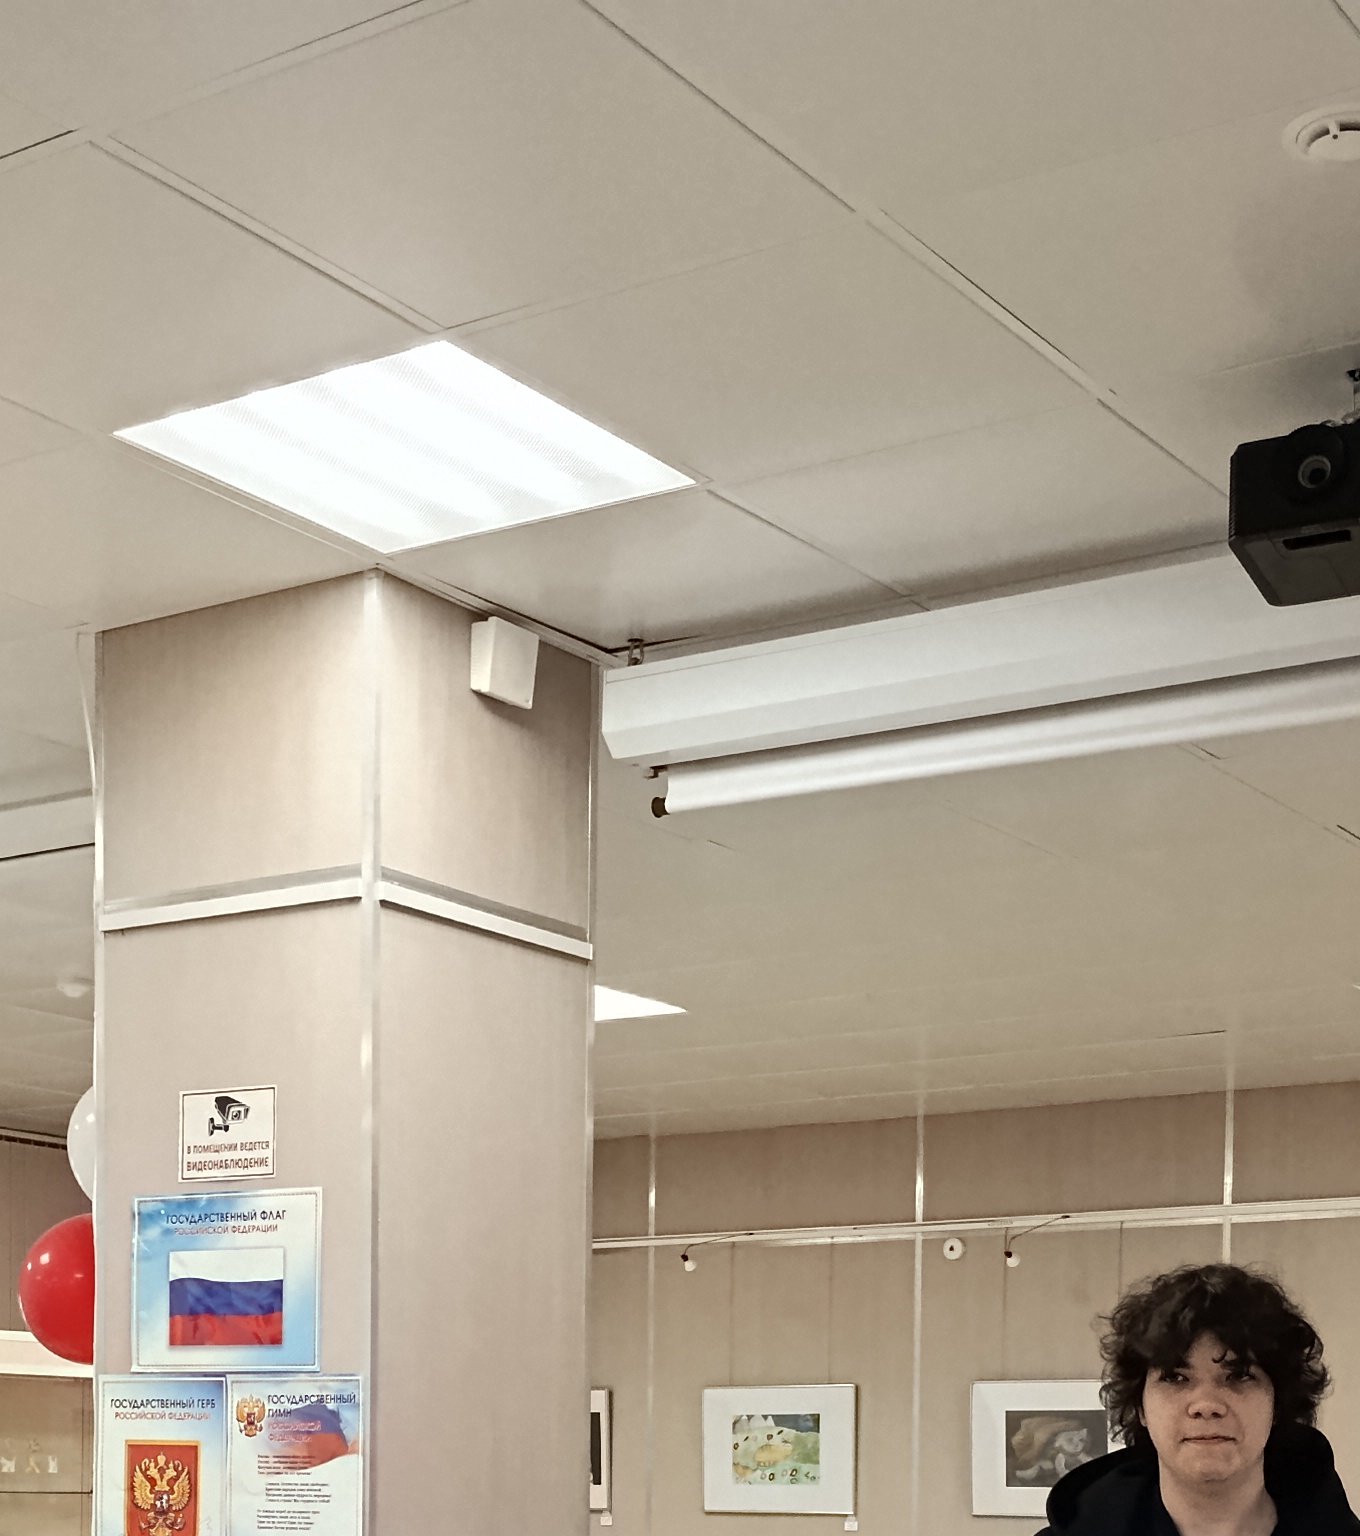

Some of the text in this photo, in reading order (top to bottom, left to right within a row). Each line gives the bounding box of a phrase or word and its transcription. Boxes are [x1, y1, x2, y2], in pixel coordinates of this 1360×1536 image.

[187, 1141, 270, 1154] В ПОМЕЩЕНИИ ВЕДЕТСЯ
[187, 1157, 269, 1171] ВИДЕОНАБЛЮДЕНИЕ
[167, 1209, 286, 1224] ГОСУДАРСТВЕННЫЙ ФЛАГ
[174, 1224, 278, 1235] РОССИЙСКОЙ ФЕДЕРАЦИИ
[110, 1397, 216, 1409] ГОСУДАРСТВЕННЫЙ ГЕРБ
[267, 1391, 356, 1404] ГОСУДАРСТВЕННЫЙ
[114, 1411, 211, 1421] РОССИЙСКОЙ ФЕДЕРАЦИИ
[267, 1408, 291, 1418] ГИМН
